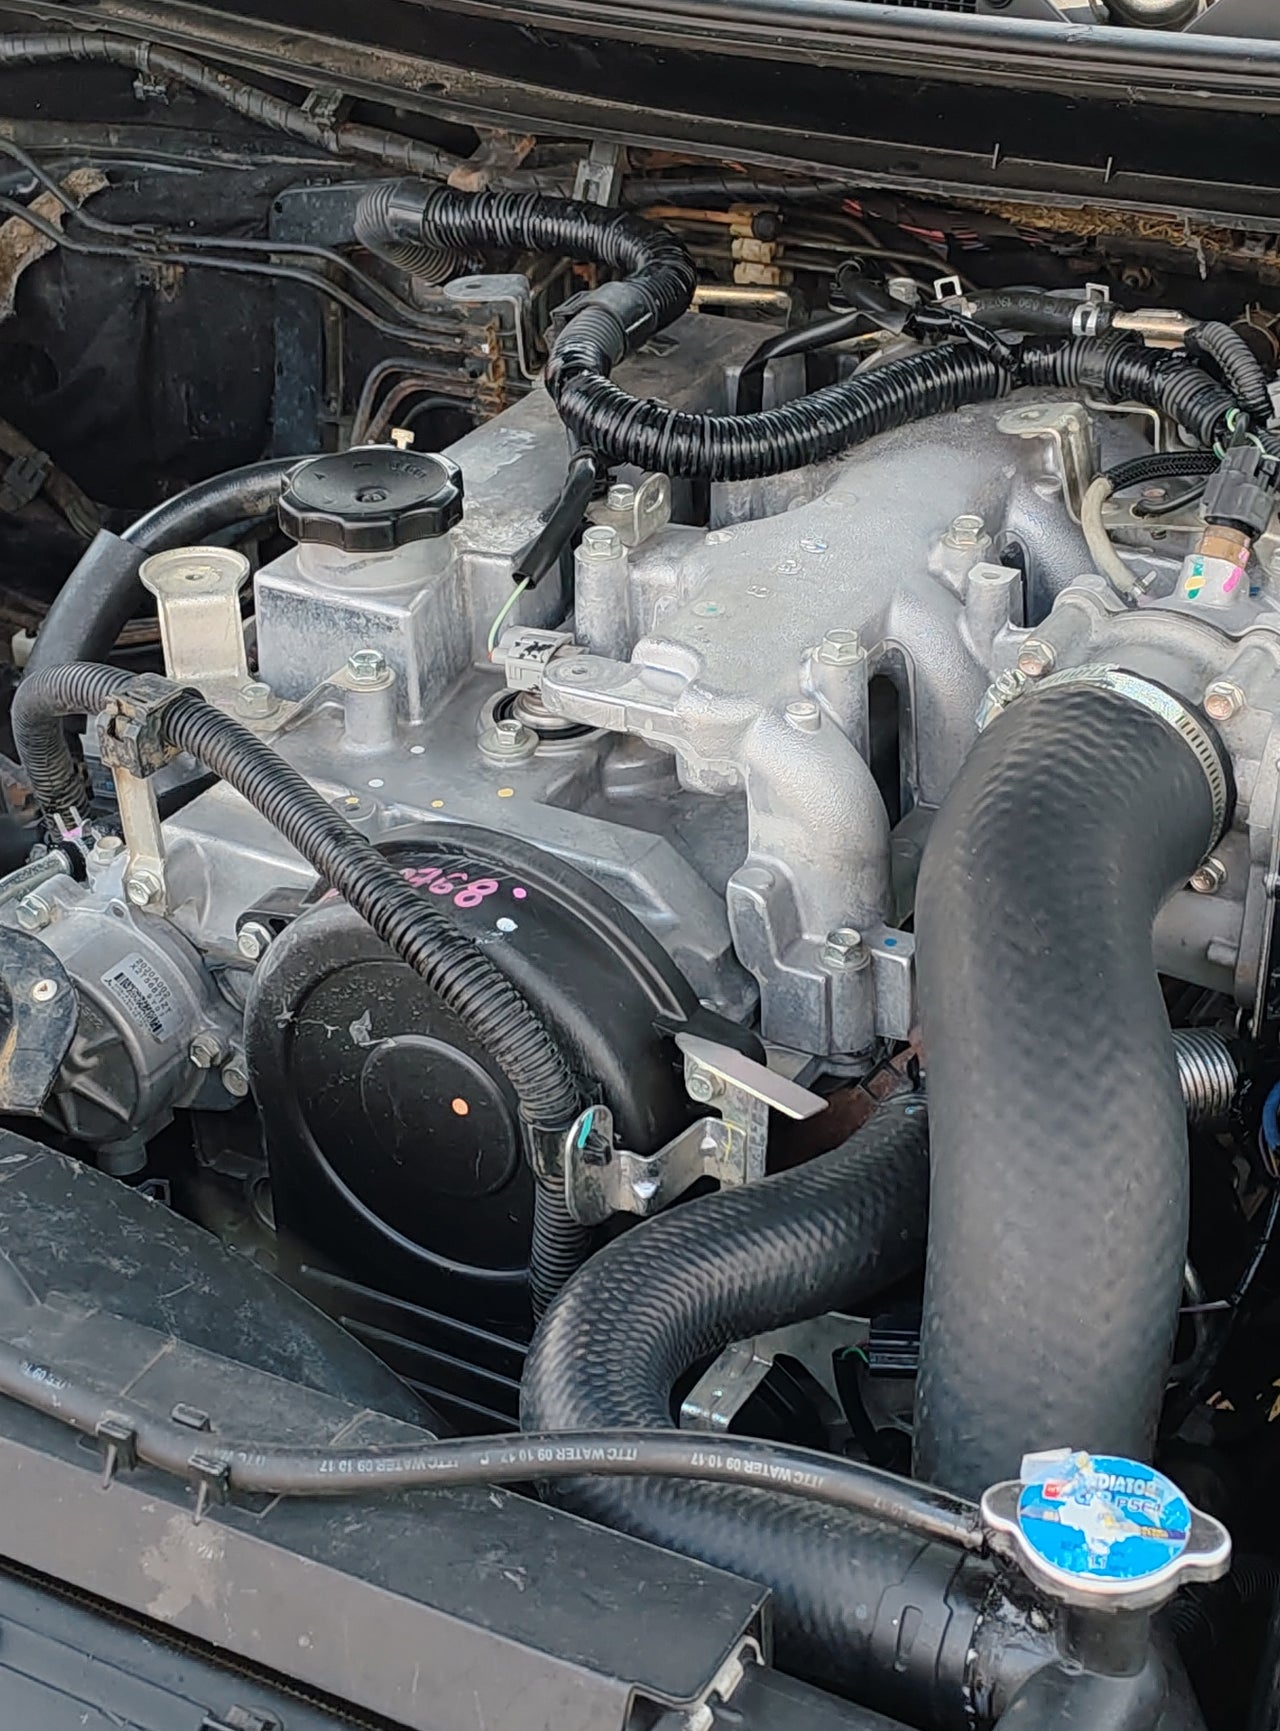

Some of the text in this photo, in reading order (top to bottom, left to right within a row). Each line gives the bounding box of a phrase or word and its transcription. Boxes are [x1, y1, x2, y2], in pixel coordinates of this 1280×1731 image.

[520, 1449, 535, 1462] 10
[538, 1447, 553, 1462] 09
[556, 1447, 606, 1461] WATER
[606, 1447, 638, 1461] ITTC
[319, 1459, 335, 1473] 17
[375, 1458, 428, 1473] WATER
[690, 1452, 824, 1488] ITTC WATER 09 10 17
